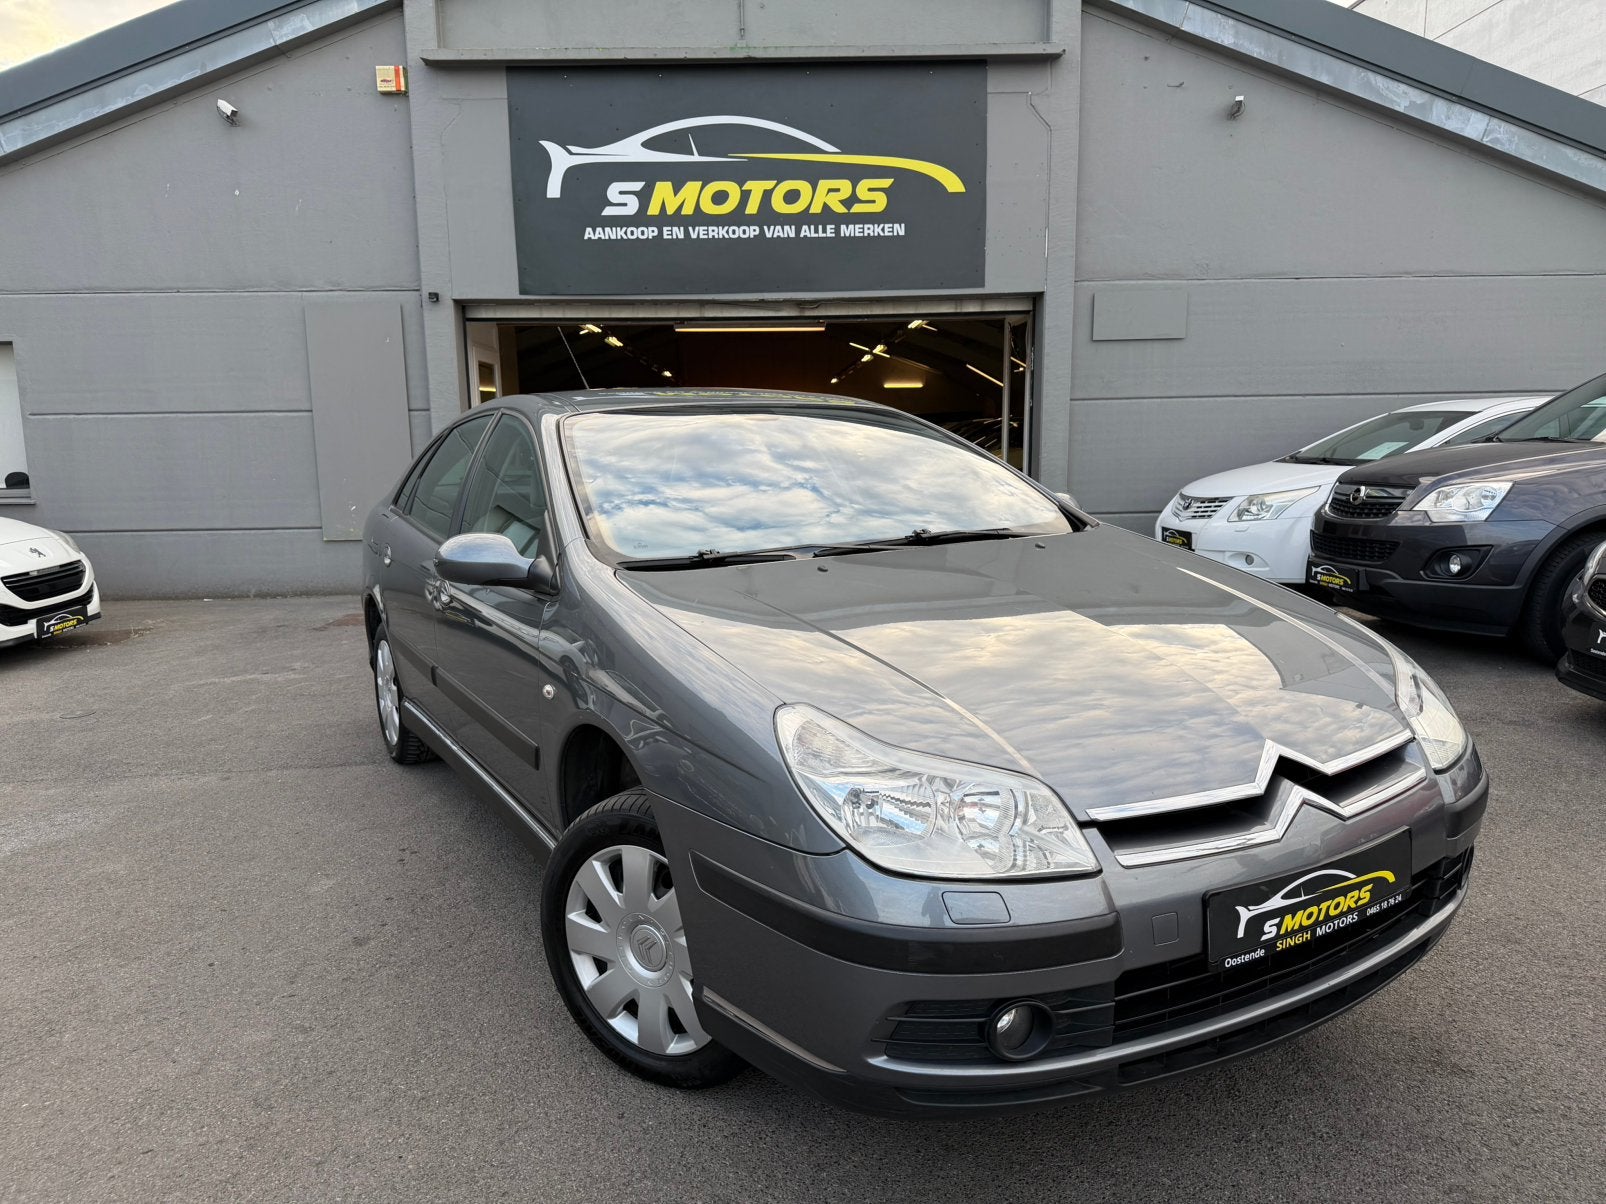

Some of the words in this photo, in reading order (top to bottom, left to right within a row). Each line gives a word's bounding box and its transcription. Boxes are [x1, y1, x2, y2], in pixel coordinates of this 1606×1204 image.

[601, 181, 646, 216] S
[647, 178, 894, 216] MOTORS
[584, 226, 658, 240] AANKOOP
[663, 226, 685, 239] EN
[688, 225, 760, 239] VERKOOP
[763, 225, 796, 238] VAN
[799, 224, 836, 238] ALLE
[840, 223, 906, 237] MERKEN
[1320, 574, 1344, 586] MOTORS
[54, 619, 78, 631] MOTORS
[1260, 917, 1281, 941] S
[1279, 883, 1374, 935] MOTORS
[1224, 947, 1265, 968] Oostende
[1276, 930, 1312, 951] SINGH
[1316, 912, 1358, 937] MOTORS
[1366, 903, 1380, 916] 0465
